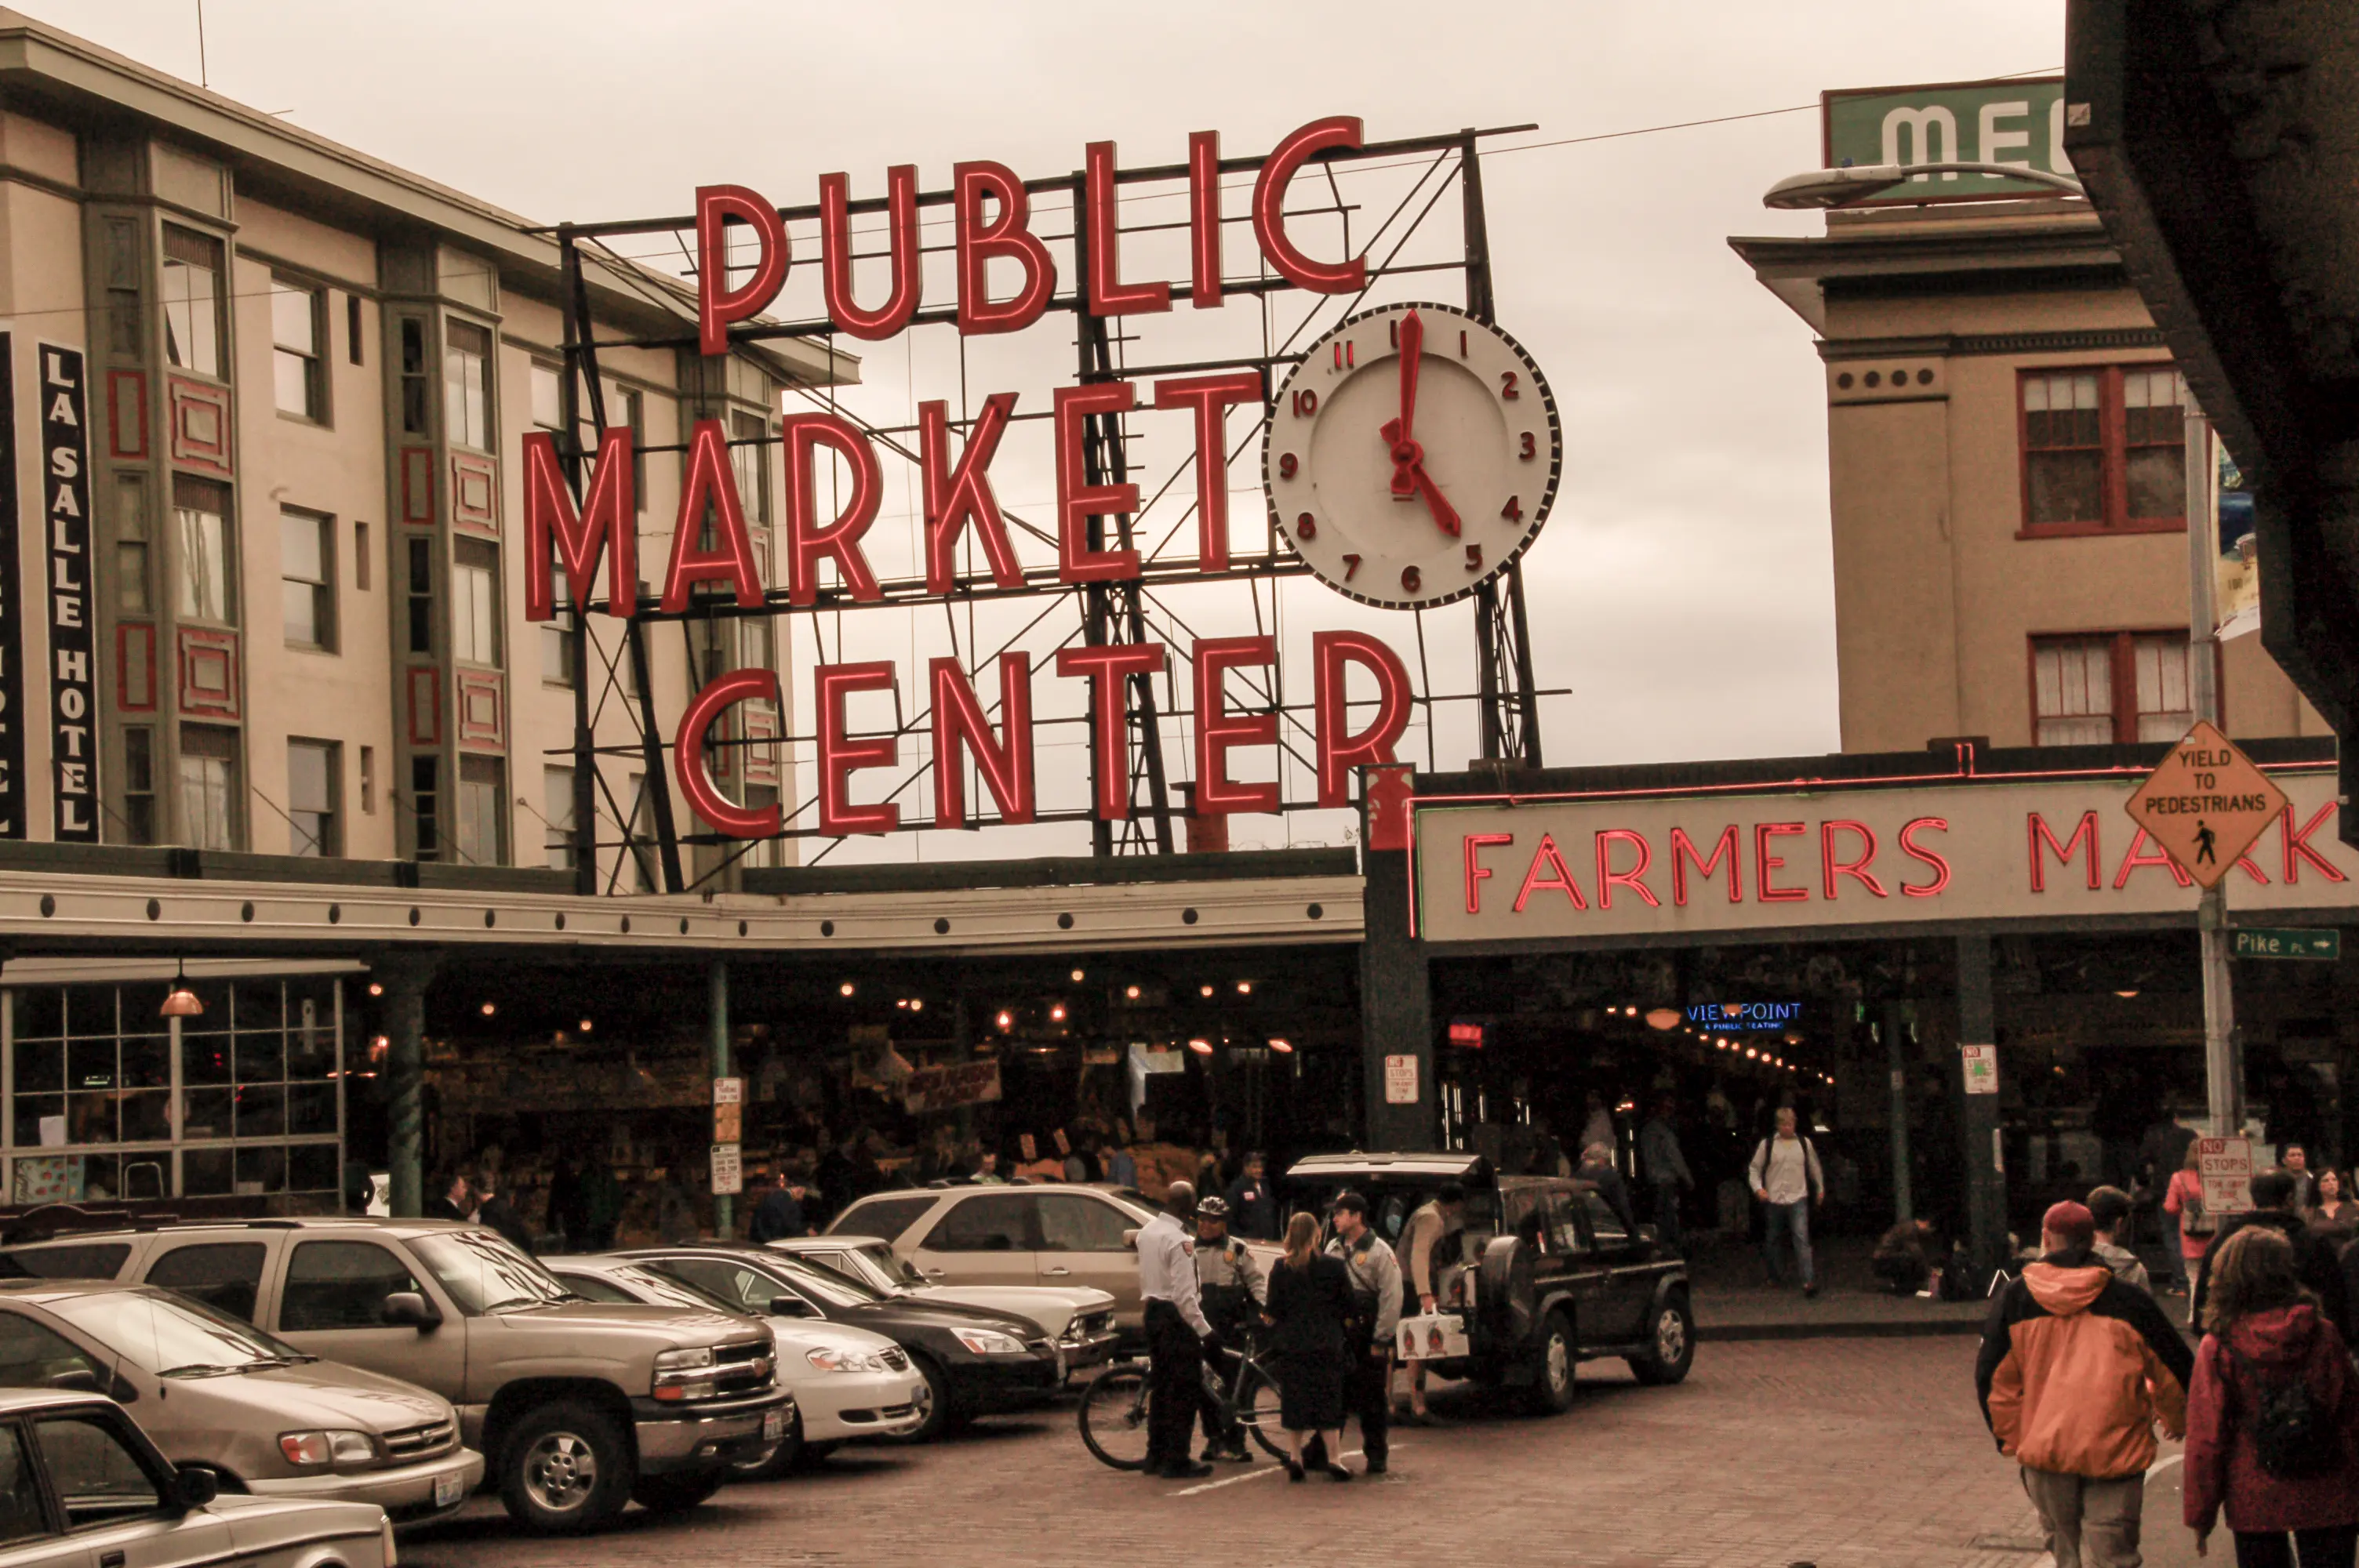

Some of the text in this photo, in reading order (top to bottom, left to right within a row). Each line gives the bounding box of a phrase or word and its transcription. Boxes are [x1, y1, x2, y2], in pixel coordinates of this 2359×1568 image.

[696, 115, 1368, 355] PUBLIC
[1334, 340, 1354, 369] 11
[1460, 330, 1468, 358] 1
[1500, 372, 1519, 400] 2
[1292, 389, 1318, 418] 10
[1518, 431, 1536, 461] 3
[1278, 452, 1299, 481] 9
[522, 371, 1265, 621] MARKET
[1501, 495, 1523, 524] 4
[1297, 512, 1317, 540] 8
[1342, 554, 1361, 583] 7
[1465, 543, 1483, 572] 5
[48, 353, 89, 832] LA SALLE HOTEL
[1401, 565, 1421, 592] 6
[674, 630, 1412, 839] CENTER
[2179, 749, 2231, 768] YIELD
[2194, 773, 2215, 790] TO
[2146, 793, 2266, 815] PEDESTRIANS
[1463, 817, 1951, 915] FARMERS
[2237, 931, 2281, 953] Pike
[1713, 1022, 1742, 1031] PUBLIC
[2202, 1140, 2223, 1152] NO
[2205, 1159, 2248, 1171] STOPS
